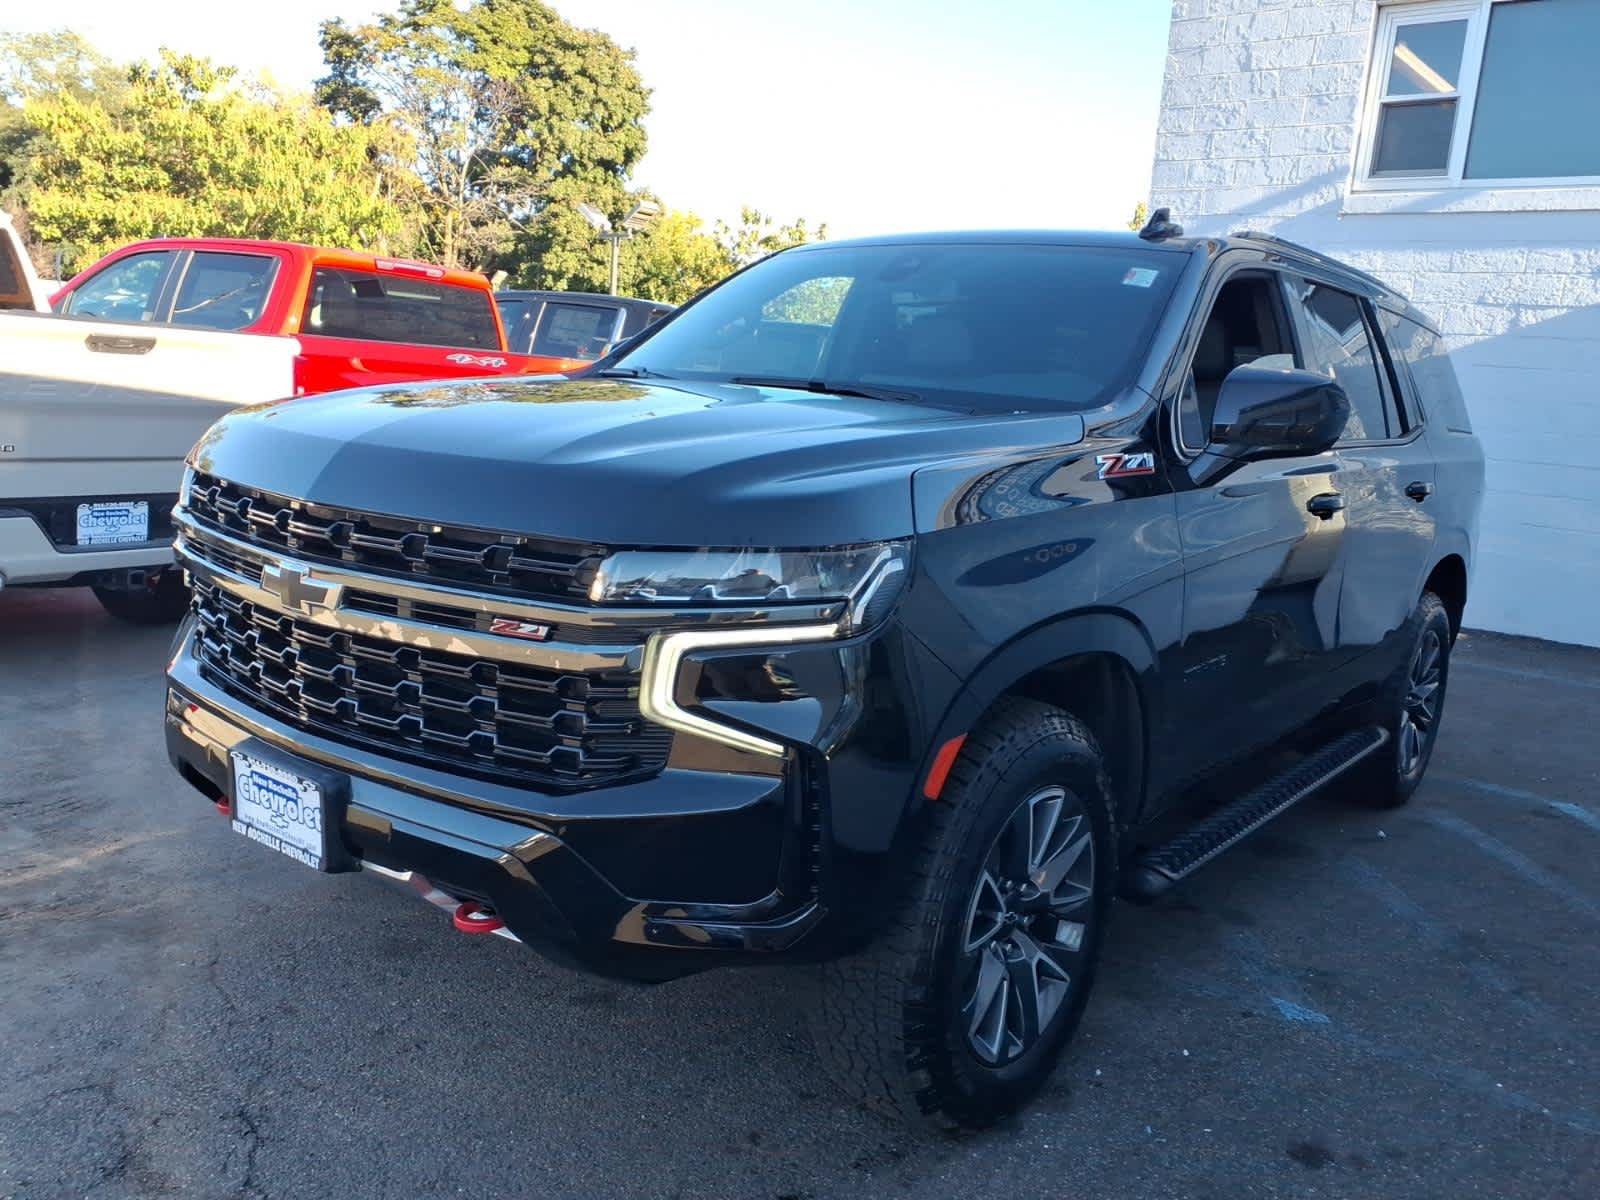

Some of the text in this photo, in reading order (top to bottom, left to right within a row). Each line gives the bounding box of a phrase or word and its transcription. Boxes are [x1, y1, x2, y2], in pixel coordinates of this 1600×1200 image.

[1096, 452, 1155, 480] Z71
[79, 513, 146, 528] Chevrolet
[489, 618, 550, 640] Z71
[238, 774, 321, 832] Chevrolet
[232, 819, 247, 836] NEW
[247, 825, 281, 851] ROCHELLE
[281, 841, 321, 870] CHEVROLET
